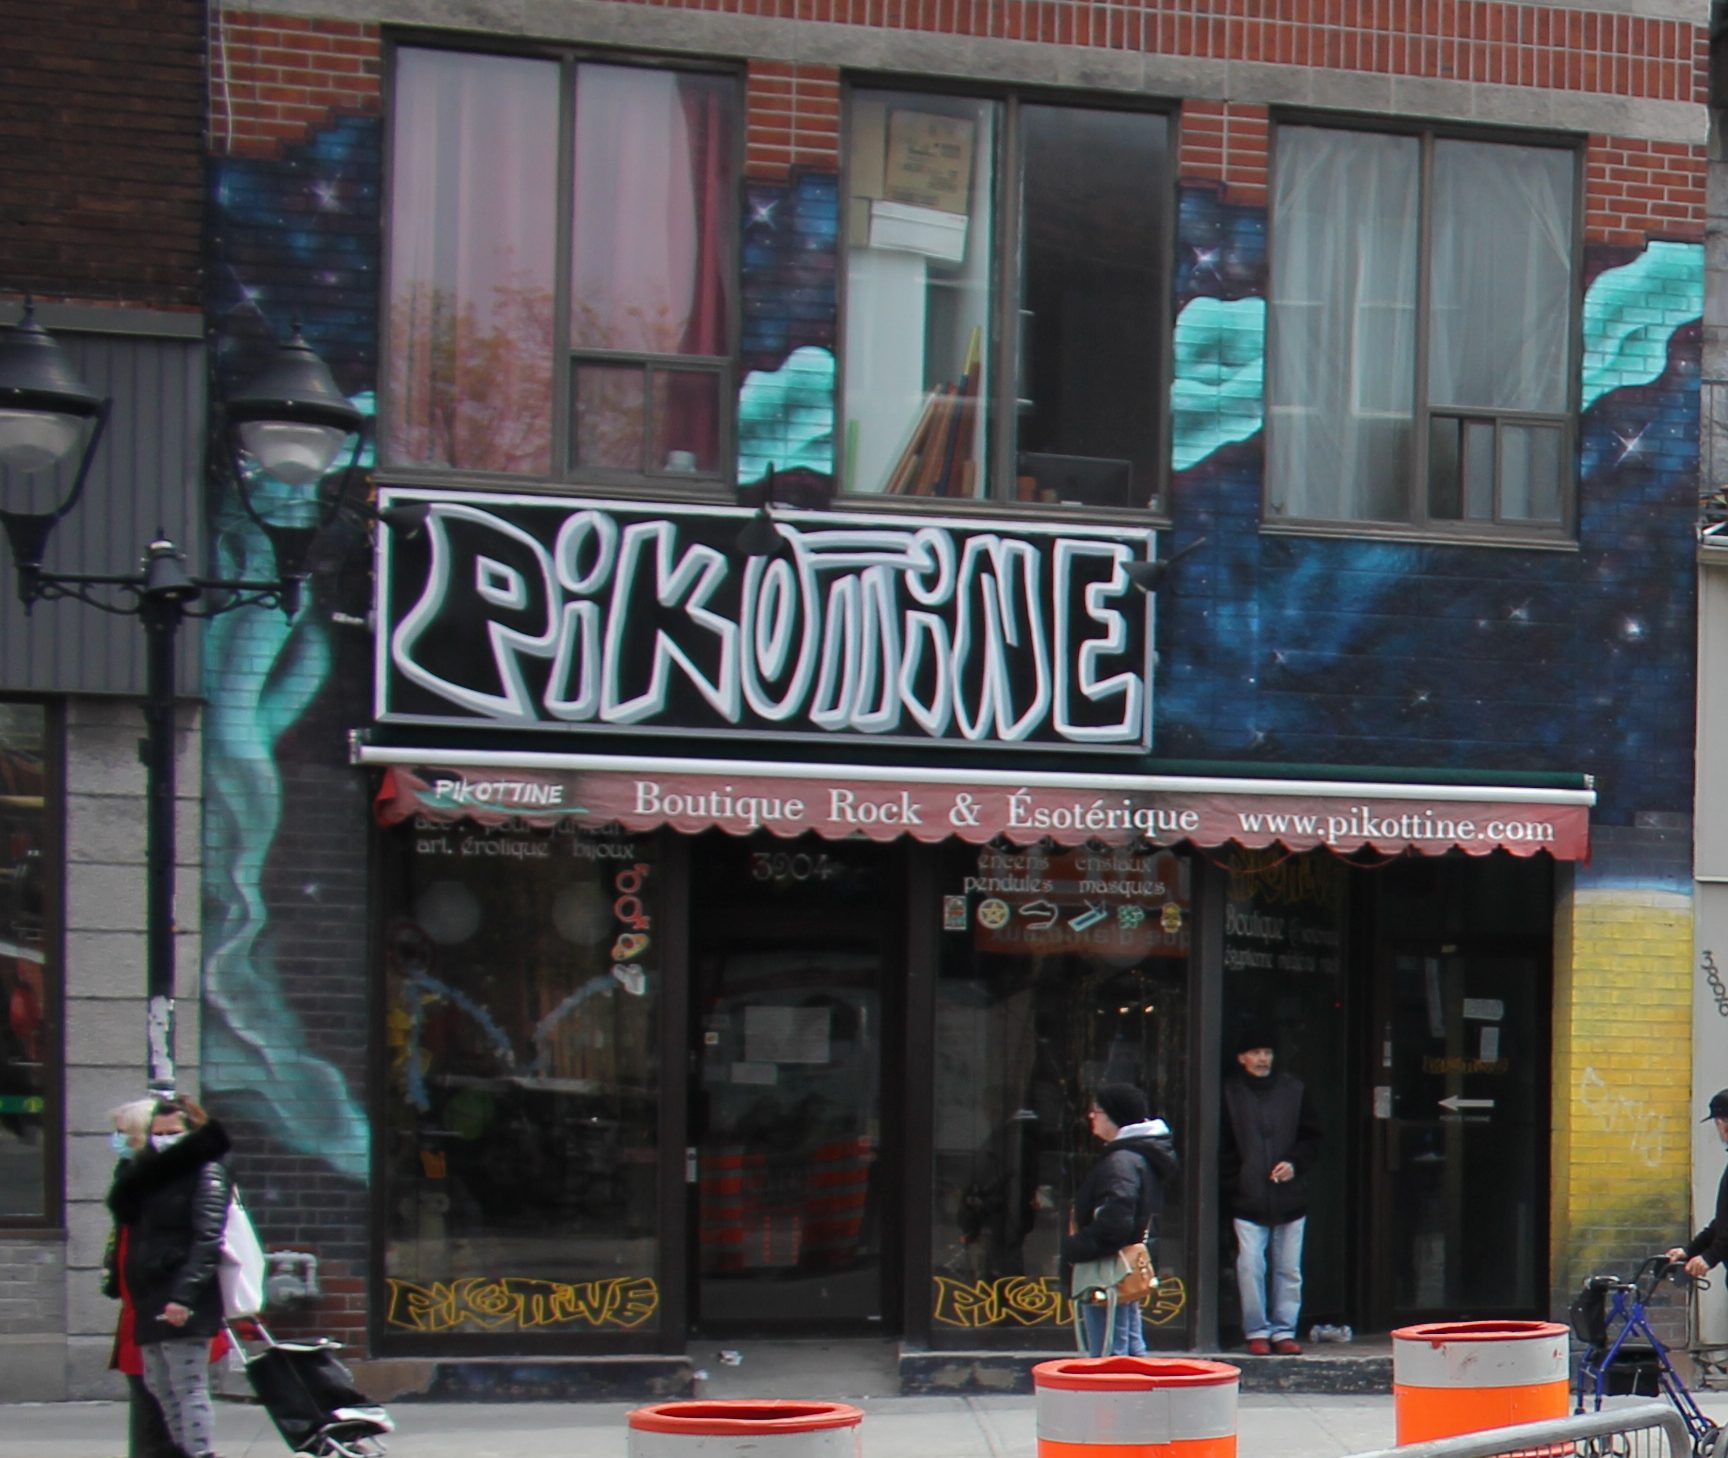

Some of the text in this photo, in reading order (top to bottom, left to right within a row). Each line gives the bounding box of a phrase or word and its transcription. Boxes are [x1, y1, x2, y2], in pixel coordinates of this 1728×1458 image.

[634, 781, 804, 830] Boutique
[828, 788, 922, 826] Rock
[947, 792, 981, 827] &
[1006, 788, 1200, 838] Ésotérique
[1238, 806, 1555, 843] www.pikottine.com
[963, 874, 1166, 898] pendules masques
